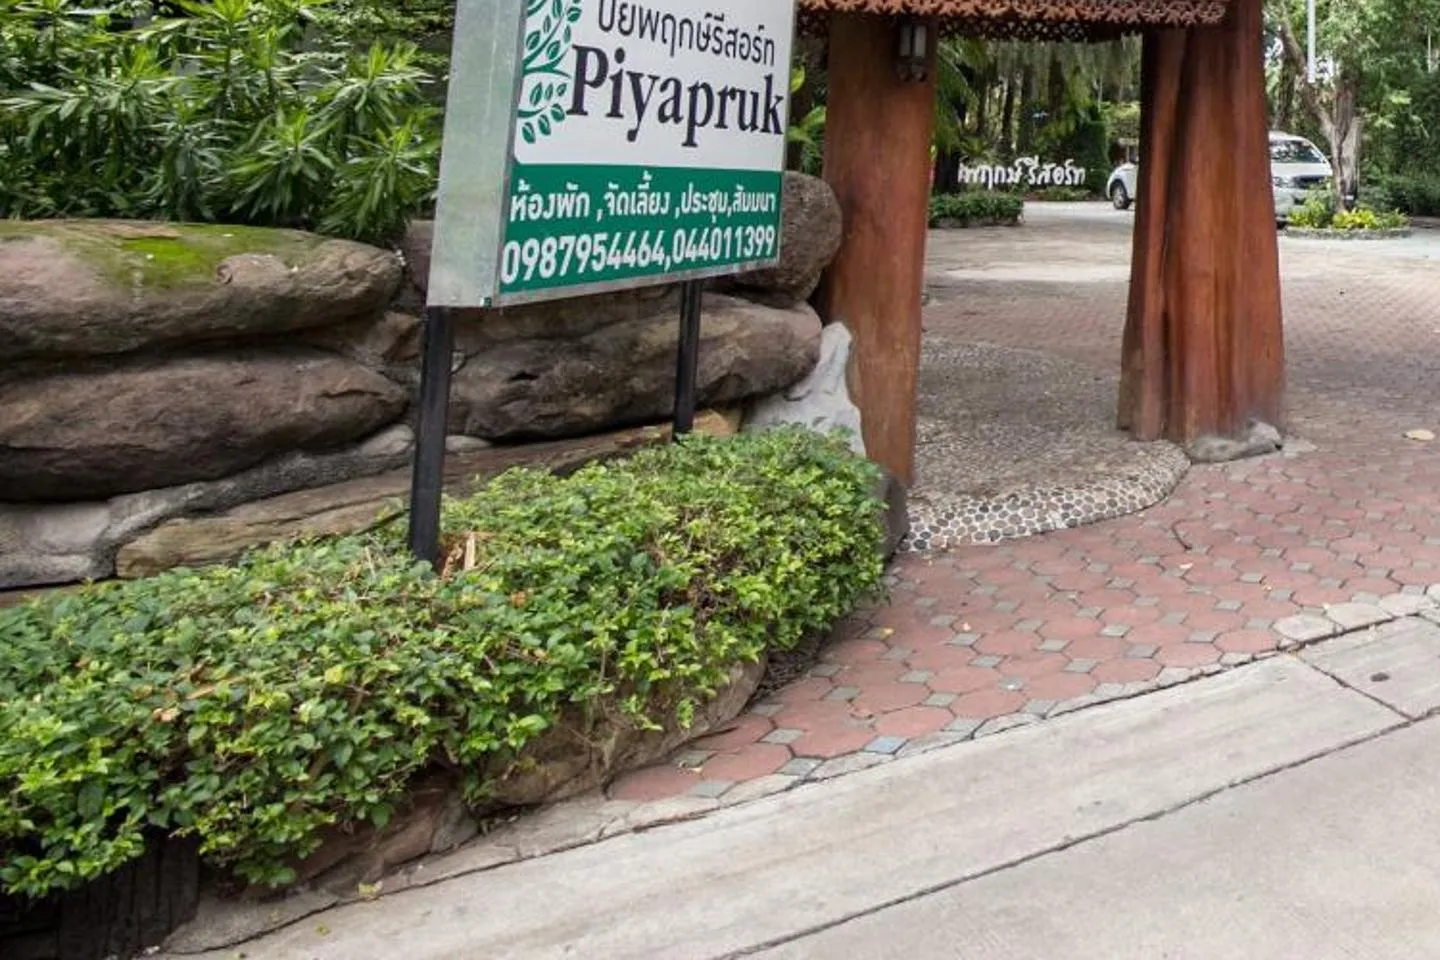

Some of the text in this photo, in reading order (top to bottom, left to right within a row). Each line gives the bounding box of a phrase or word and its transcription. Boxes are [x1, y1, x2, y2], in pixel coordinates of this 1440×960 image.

[566, 44, 783, 147] Piyapruk
[510, 180, 589, 222] ห้องพัก
